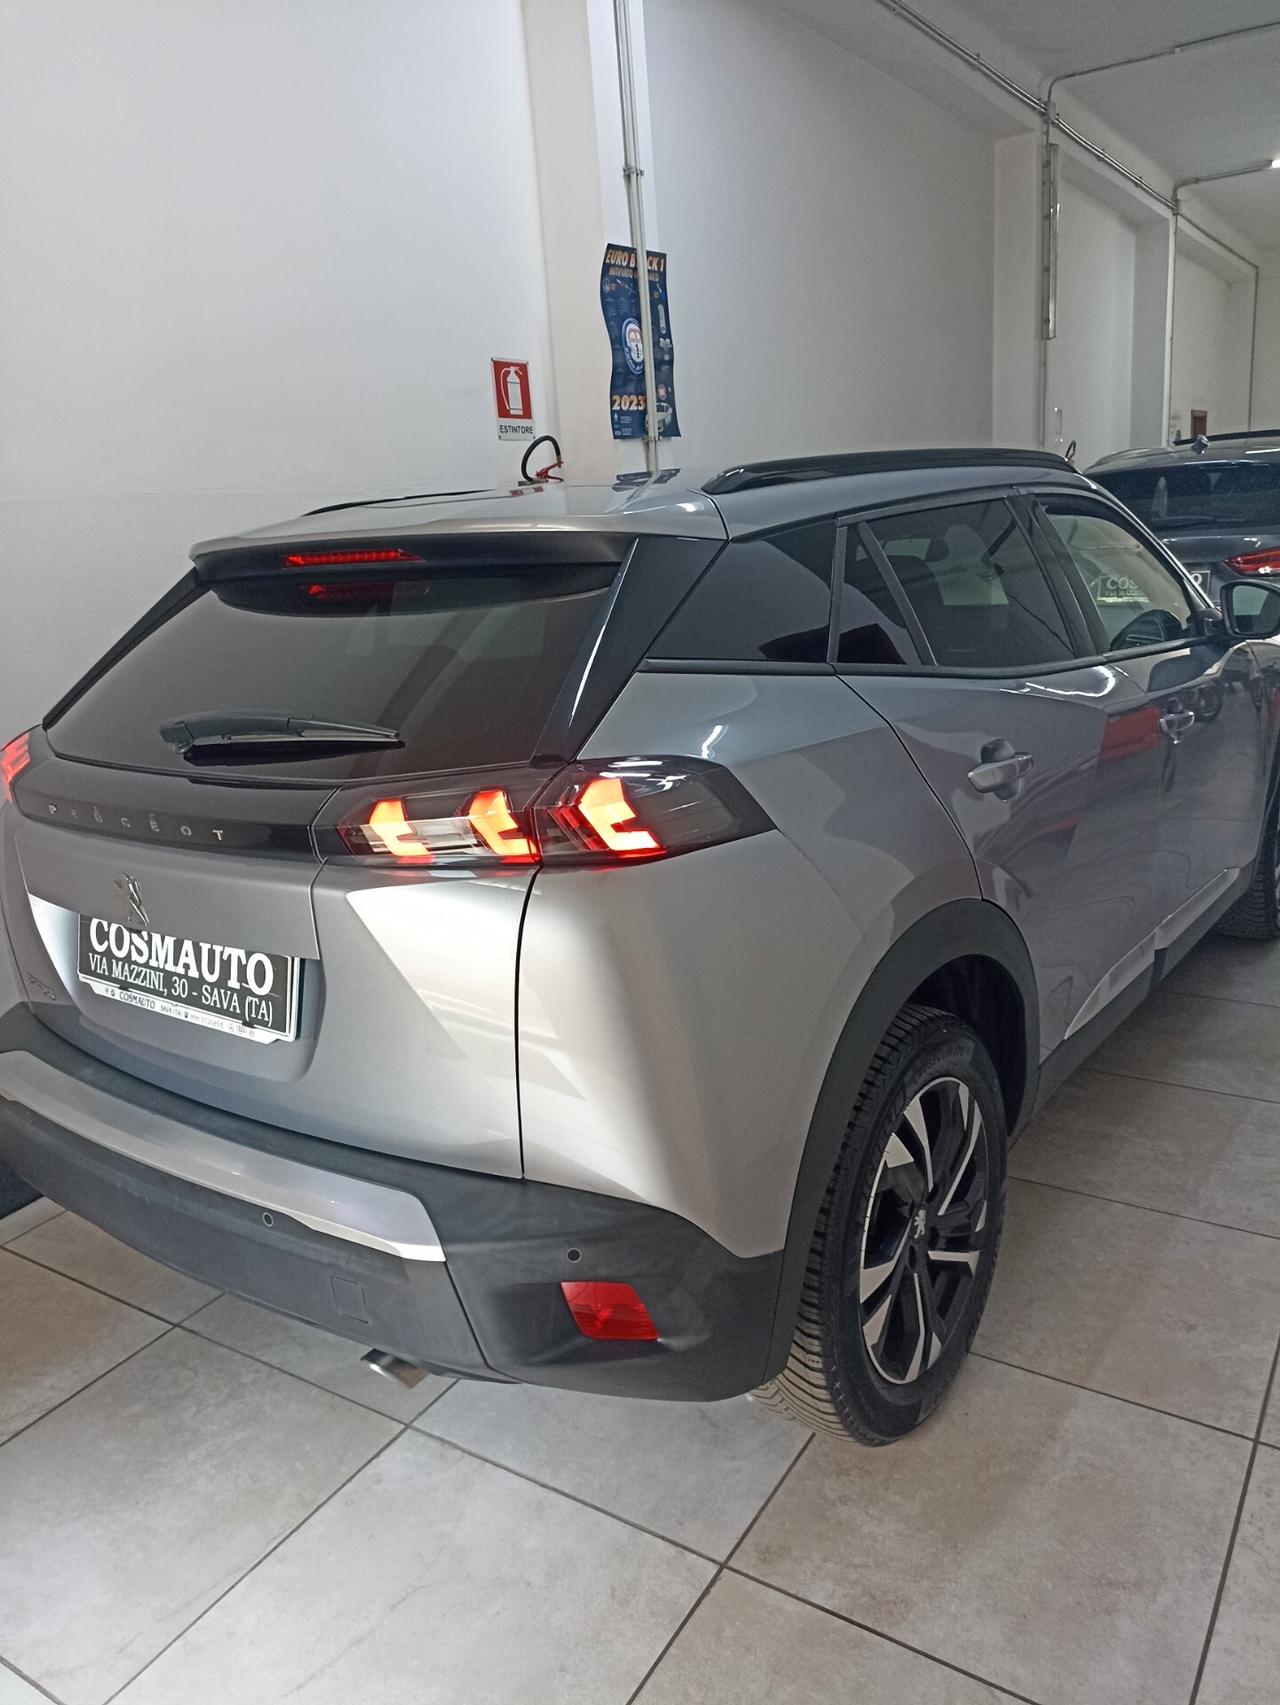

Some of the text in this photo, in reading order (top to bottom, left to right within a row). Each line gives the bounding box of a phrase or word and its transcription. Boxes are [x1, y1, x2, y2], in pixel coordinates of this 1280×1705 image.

[605, 250, 628, 267] EURO
[629, 254, 659, 271] BCK
[612, 395, 647, 410] 2023
[500, 424, 534, 434] ESTINTORE
[89, 917, 274, 996] COSMAUTO
[88, 953, 109, 976] VIA
[112, 959, 168, 996] MAZZINI,
[171, 975, 188, 998] 30
[201, 984, 241, 1013] SAVA
[245, 995, 272, 1028] (TA)
[119, 991, 156, 1009] COSMAUTO
